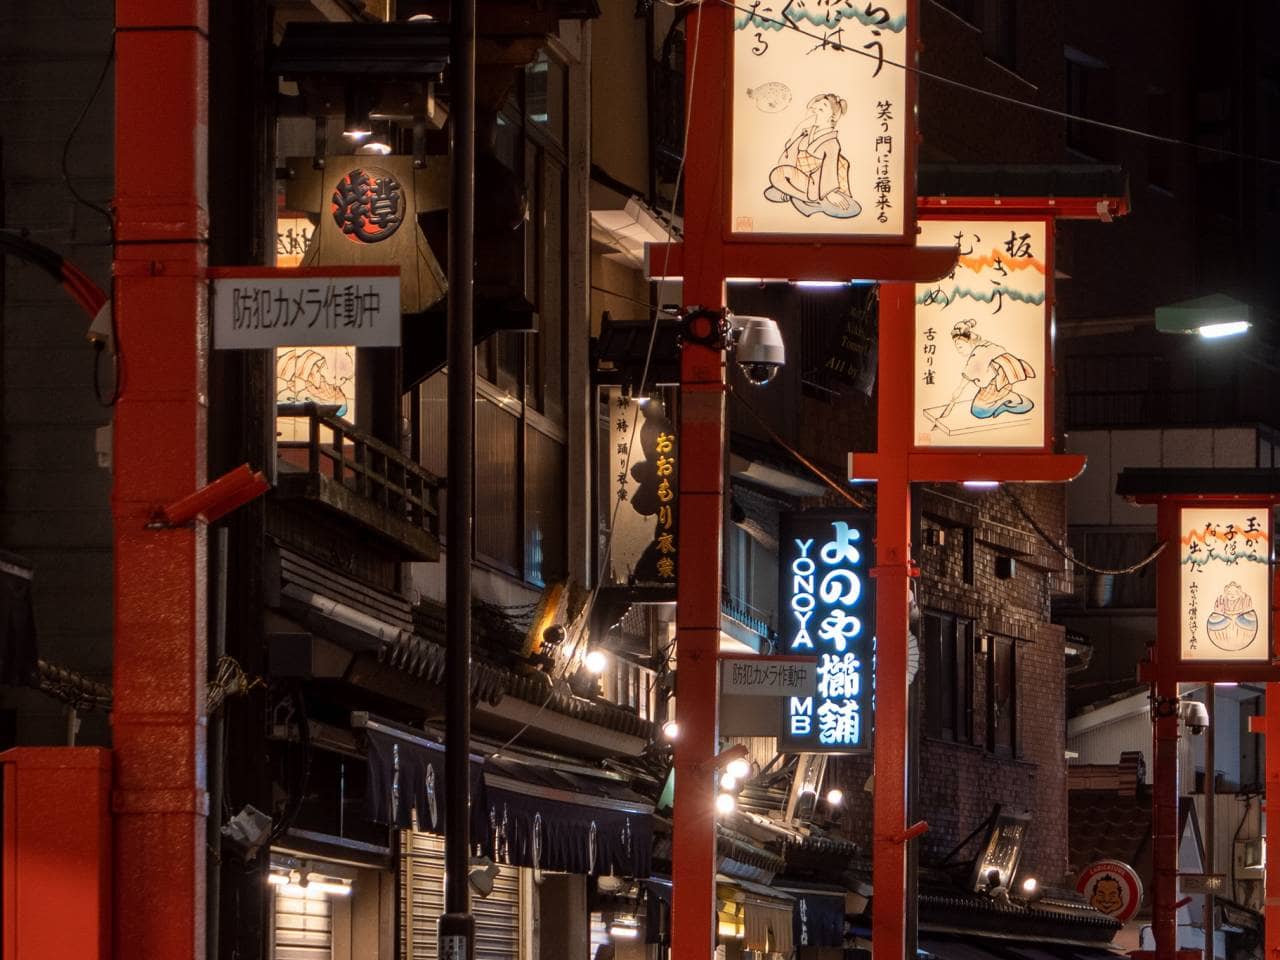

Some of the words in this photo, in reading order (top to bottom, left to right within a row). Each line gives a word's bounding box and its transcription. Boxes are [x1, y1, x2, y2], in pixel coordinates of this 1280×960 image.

[874, 100, 893, 224] 笑う門には福来る
[232, 284, 380, 330] 防犯カメラ作動中
[922, 327, 937, 386] 舌切り雀
[791, 538, 816, 648] YONOYA
[732, 663, 807, 688] 防犯カメラ作動中
